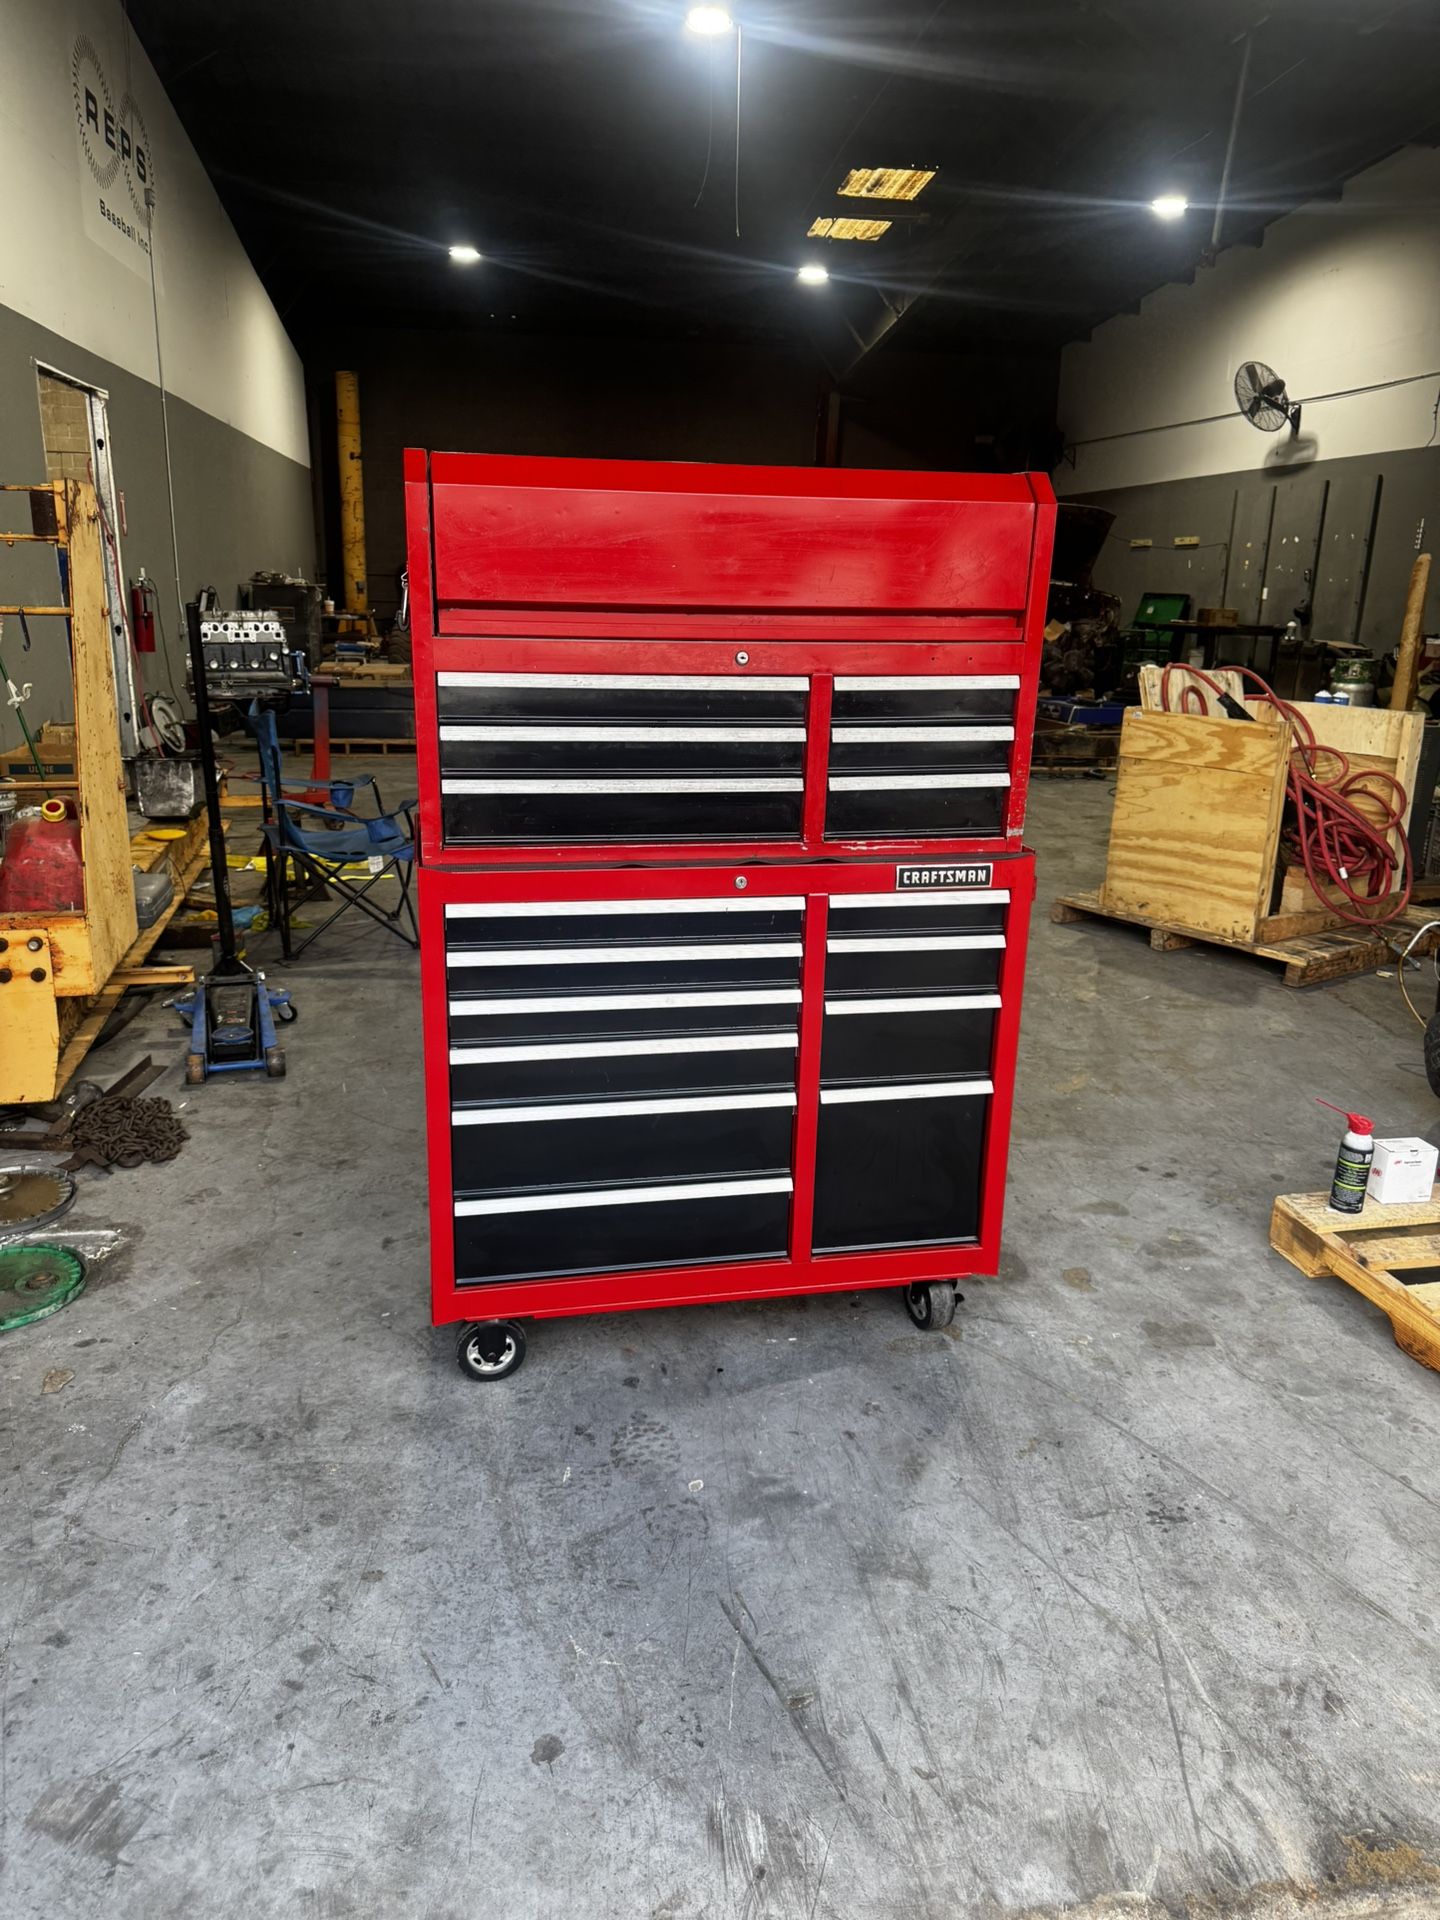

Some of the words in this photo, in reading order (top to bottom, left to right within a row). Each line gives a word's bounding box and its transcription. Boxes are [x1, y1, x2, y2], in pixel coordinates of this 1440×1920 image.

[85, 86, 147, 184] REPS
[99, 198, 137, 242] Baseball
[28, 765, 54, 774] ULNE
[903, 869, 987, 884] CRAFTSMAN
